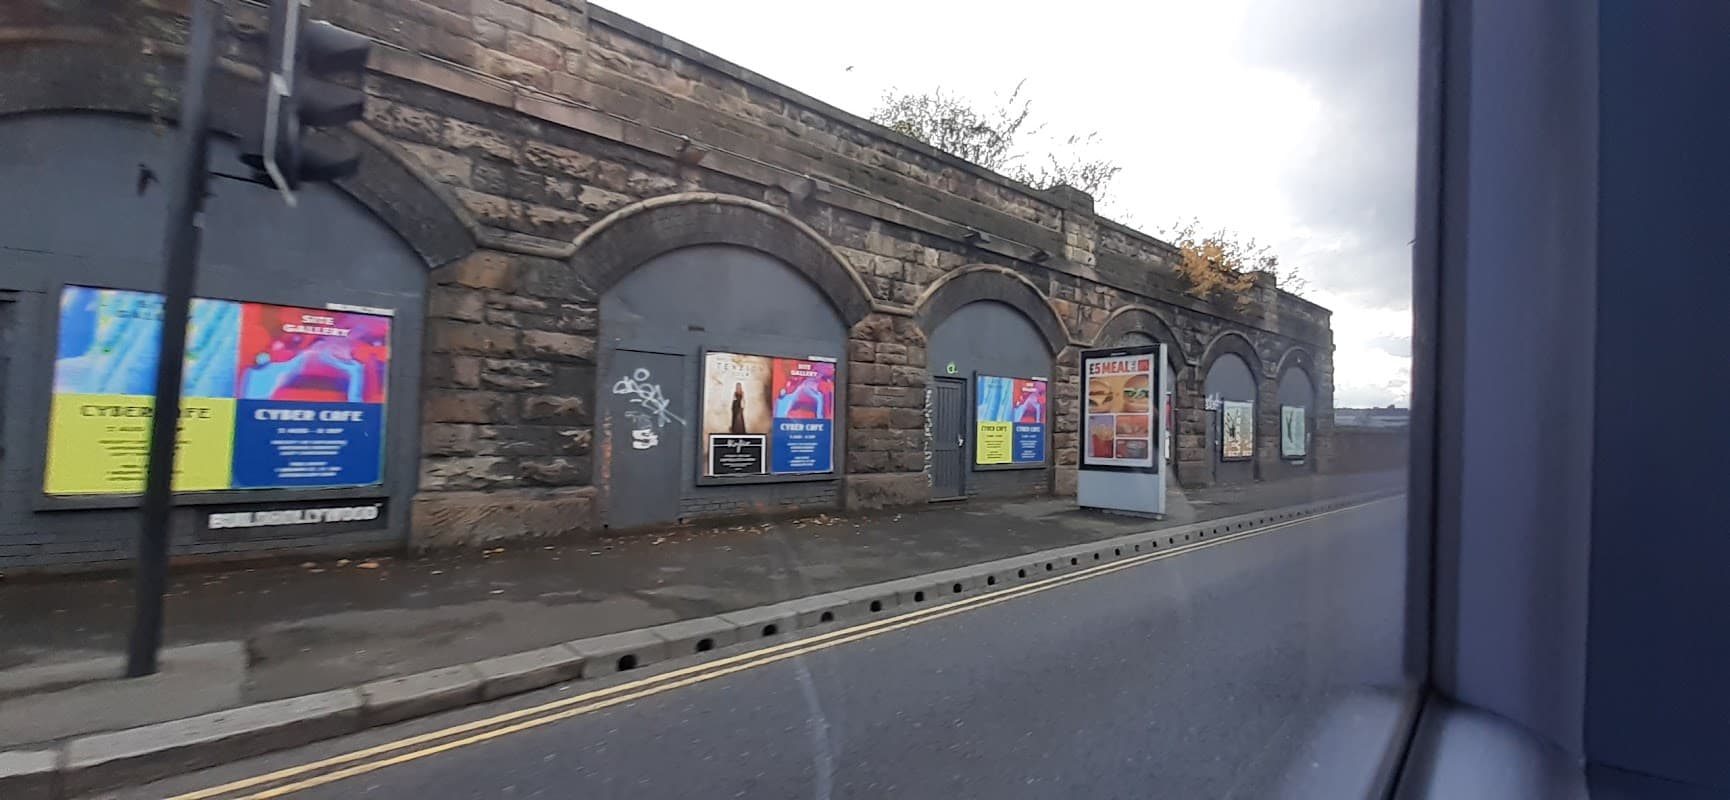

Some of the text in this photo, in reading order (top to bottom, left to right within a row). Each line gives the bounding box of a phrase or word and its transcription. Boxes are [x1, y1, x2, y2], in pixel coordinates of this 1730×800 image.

[301, 315, 335, 325] SITE
[282, 323, 351, 337] GALLERY
[1102, 360, 1130, 374] MEAL
[254, 409, 364, 422] CYBER CAFE
